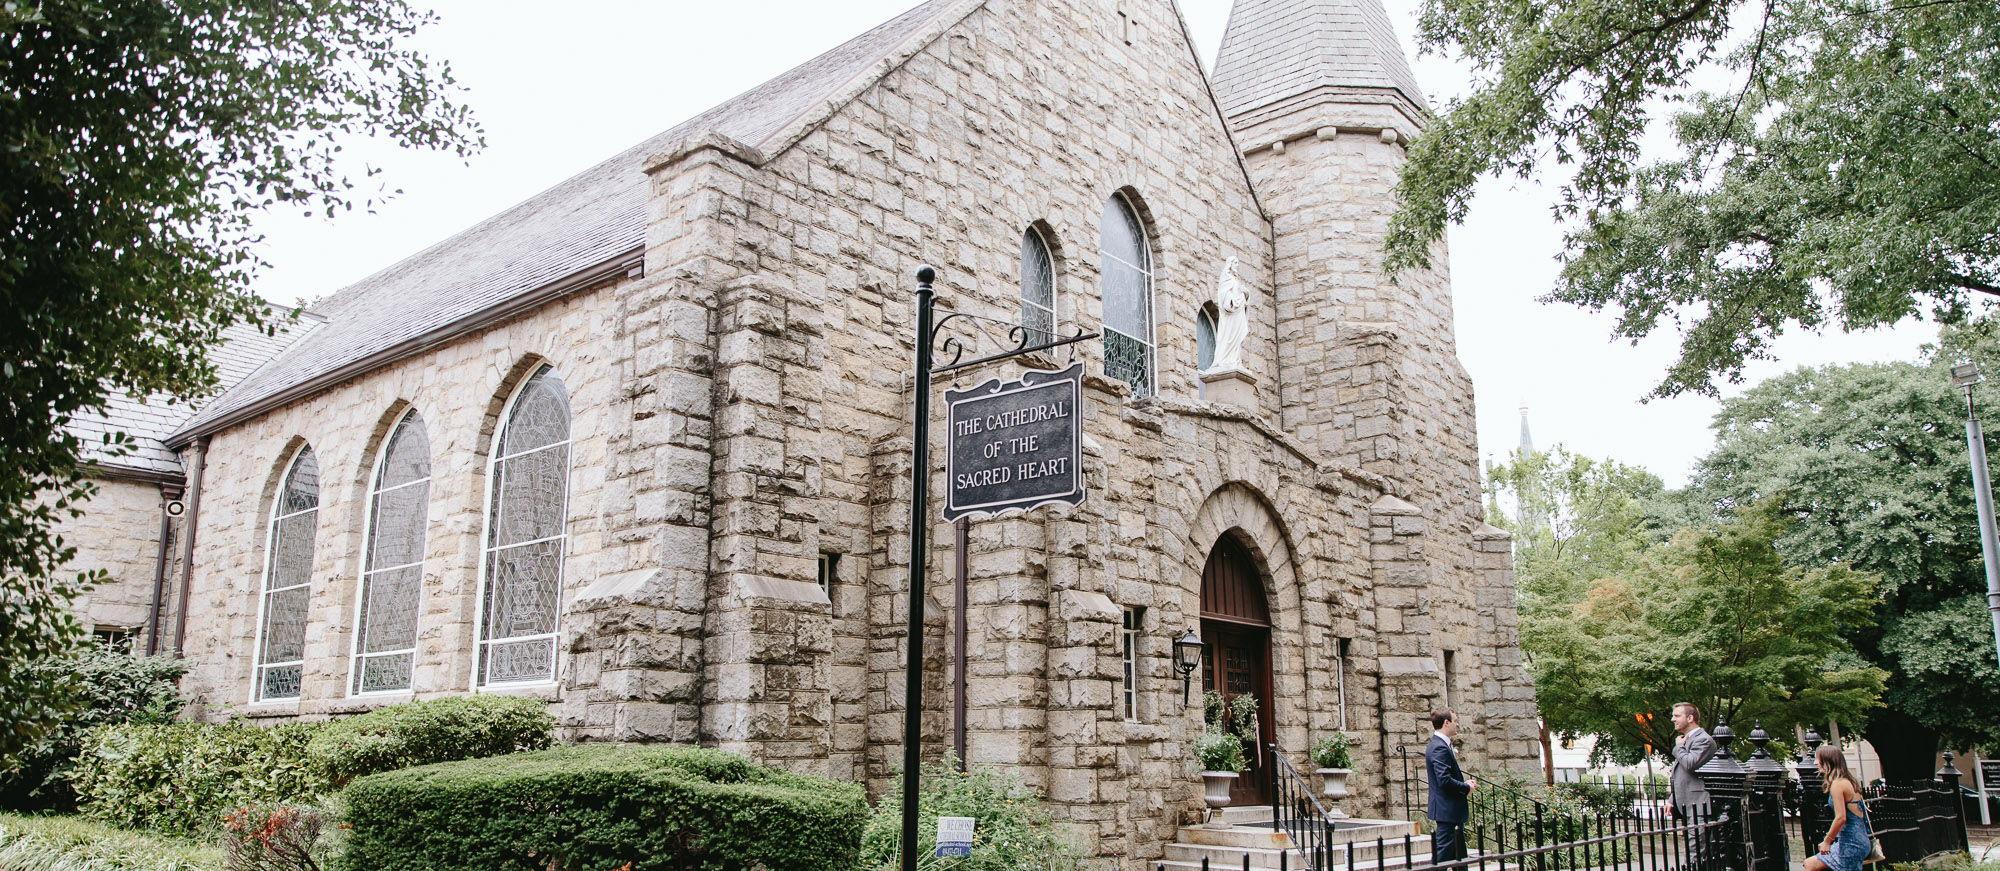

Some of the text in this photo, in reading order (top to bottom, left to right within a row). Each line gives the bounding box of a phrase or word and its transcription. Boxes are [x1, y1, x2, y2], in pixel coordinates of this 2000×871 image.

[956, 401, 1068, 436] THE CATHEDRAL
[984, 435, 1039, 459] OF THE
[956, 457, 1068, 490] SACRED HEART
